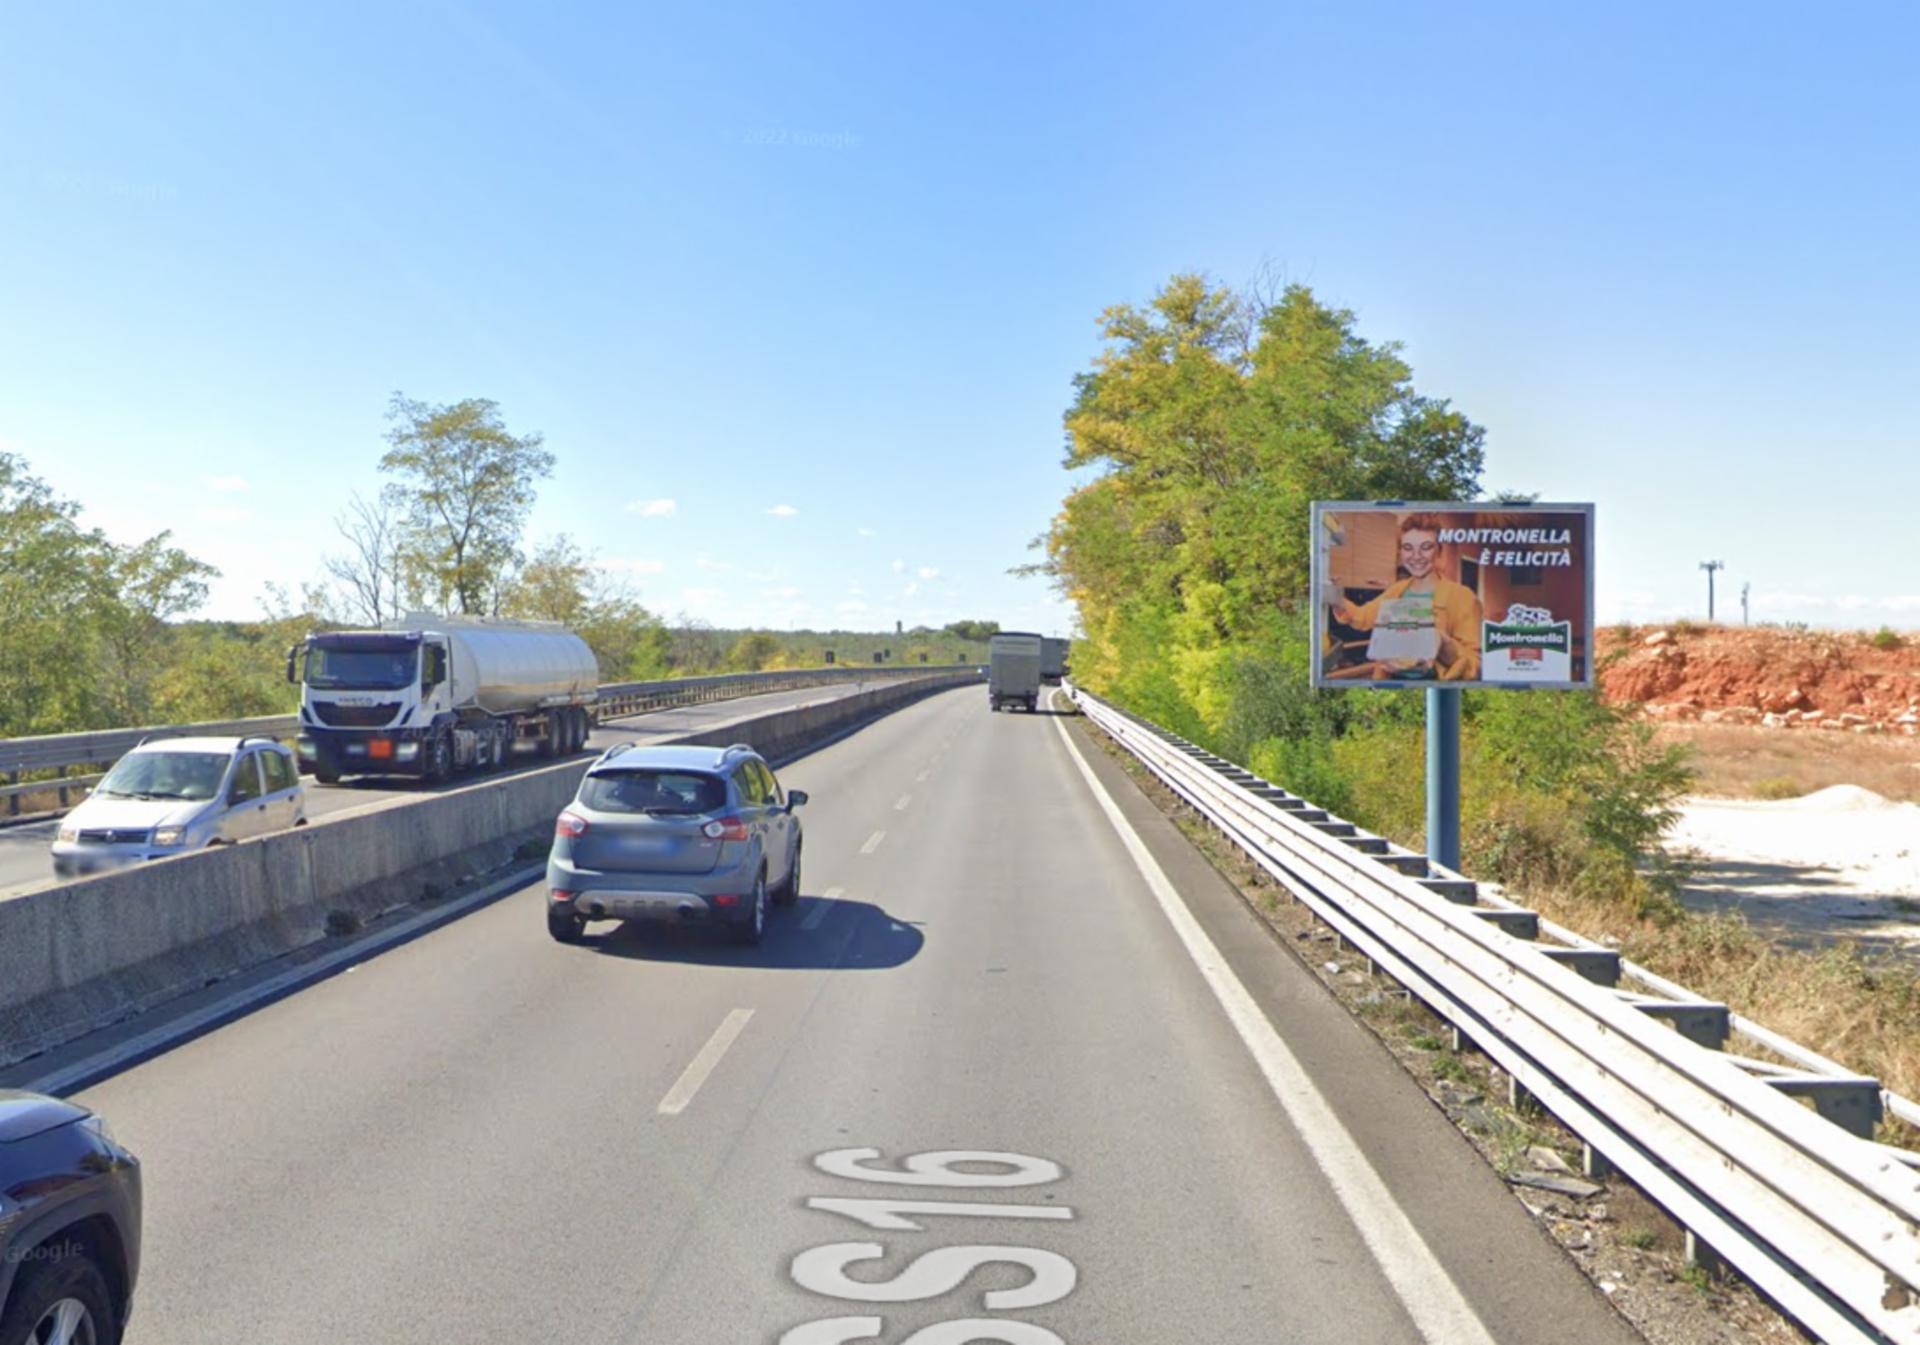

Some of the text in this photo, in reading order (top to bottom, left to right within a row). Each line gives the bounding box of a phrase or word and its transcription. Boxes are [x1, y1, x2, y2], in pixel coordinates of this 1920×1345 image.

[1438, 529, 1571, 543] MONTRONELLA
[1480, 548, 1571, 566] È FELICITÀ
[1489, 632, 1564, 645] Montronella
